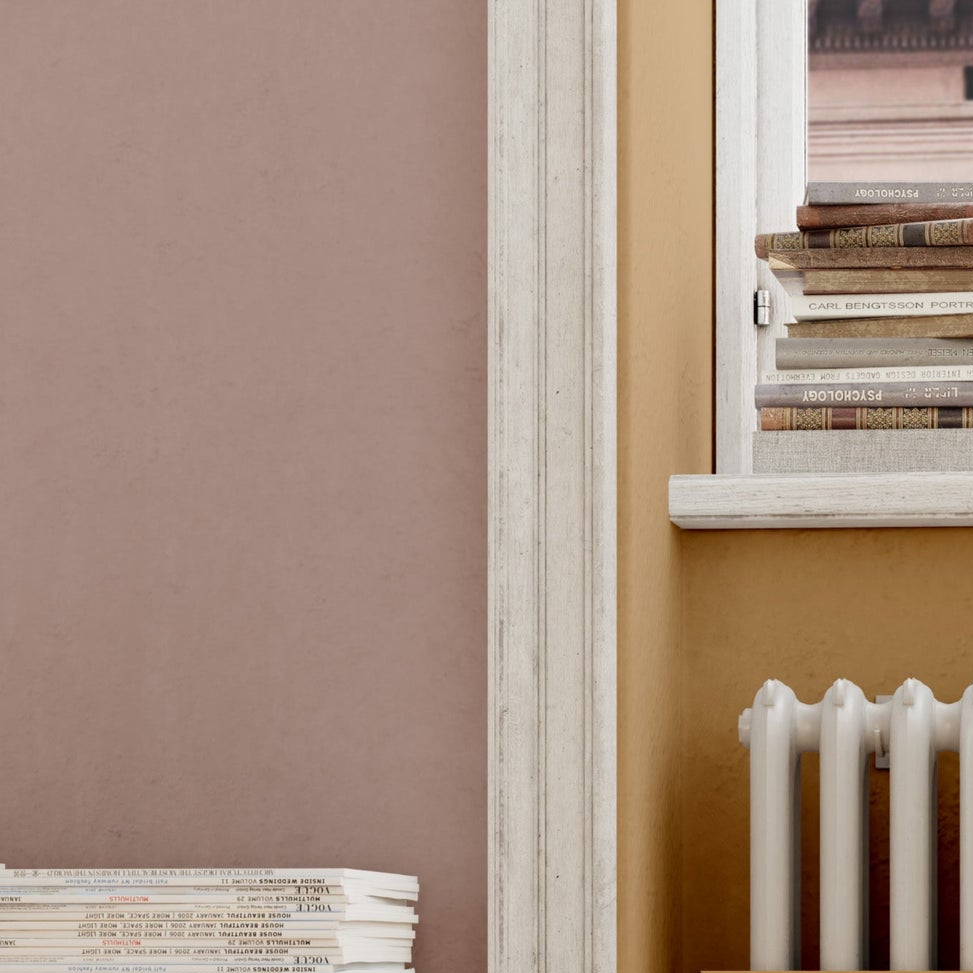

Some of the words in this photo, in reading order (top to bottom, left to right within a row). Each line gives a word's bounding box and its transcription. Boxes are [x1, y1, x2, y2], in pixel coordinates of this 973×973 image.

[856, 190, 918, 198] PSYCHOLOGY
[928, 348, 958, 356] MEISEL
[846, 372, 880, 380] GADGETS
[886, 371, 916, 379] DESIGN
[921, 370, 961, 378] INTERIOR
[802, 390, 882, 402] PSYCHOLOGY
[295, 886, 330, 894] VOGUE
[296, 904, 332, 912] VOGUE
[294, 956, 329, 964] VOGUE
